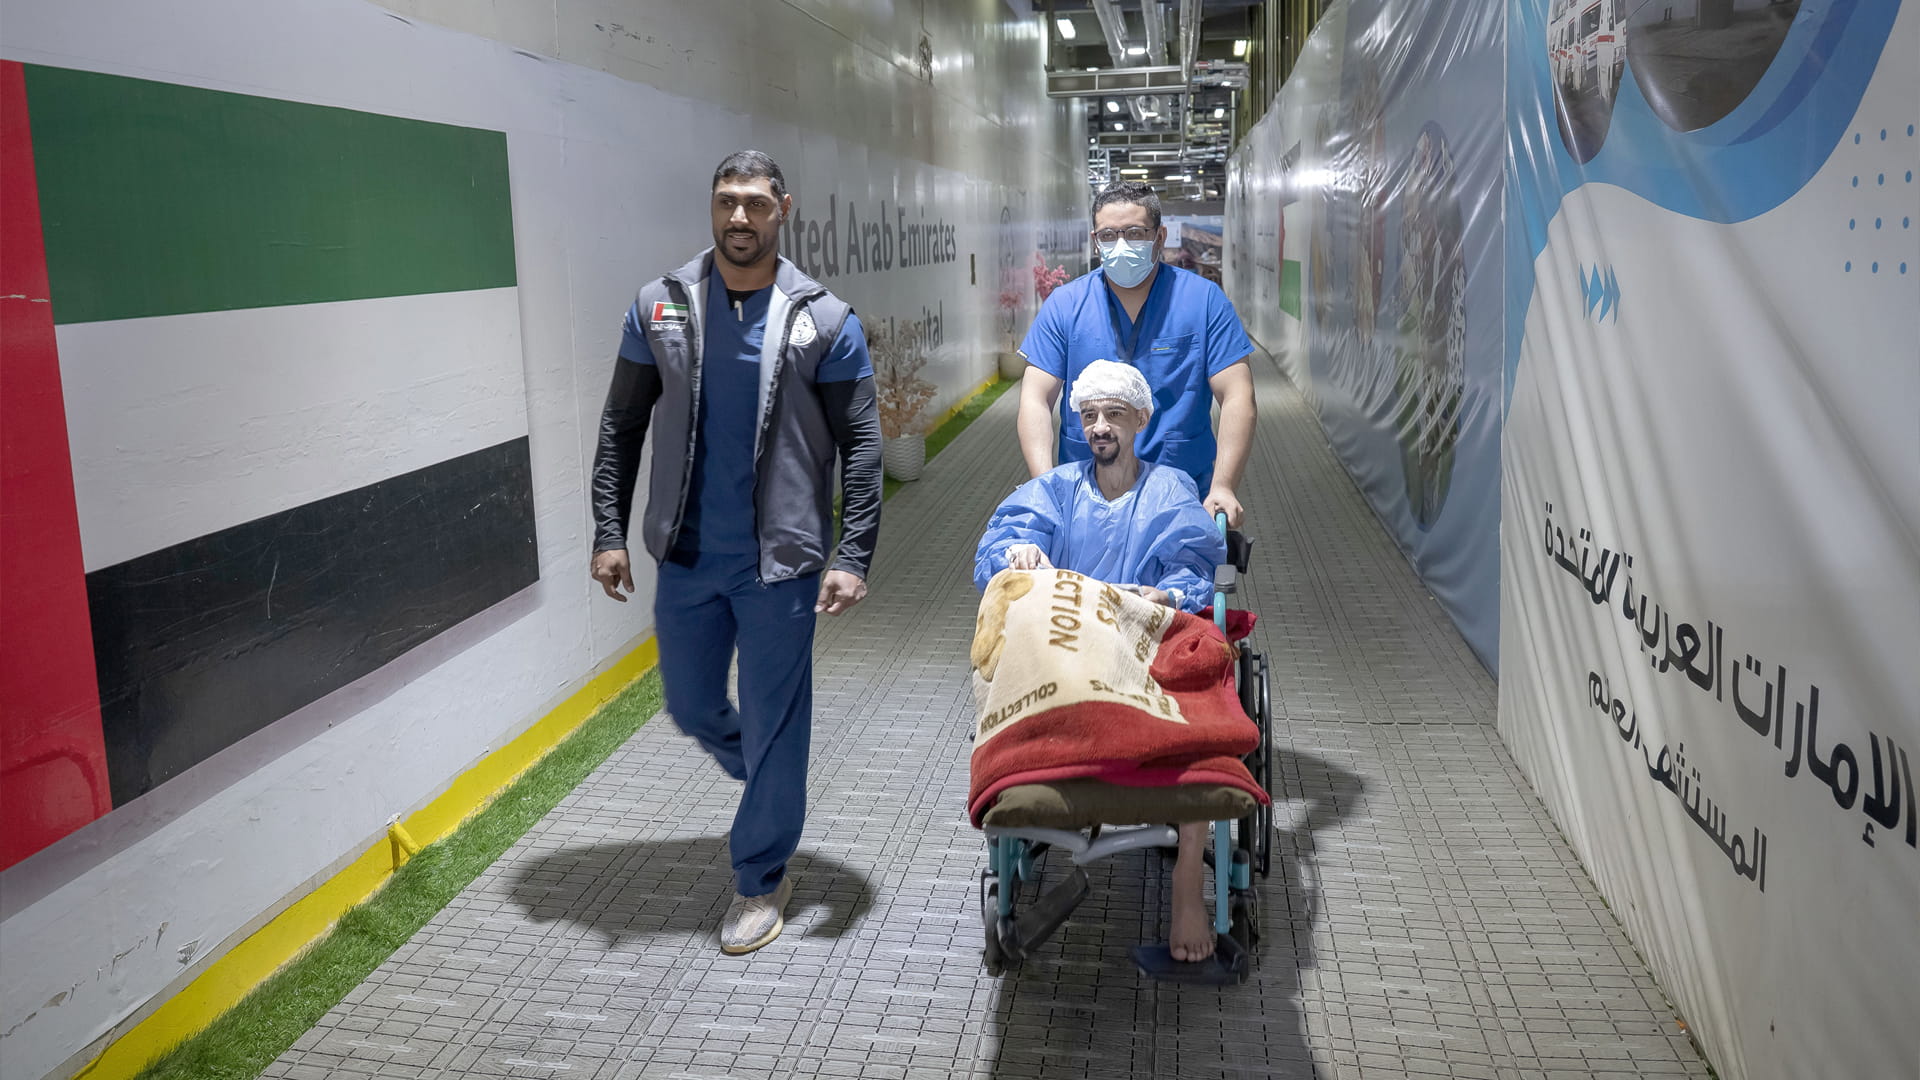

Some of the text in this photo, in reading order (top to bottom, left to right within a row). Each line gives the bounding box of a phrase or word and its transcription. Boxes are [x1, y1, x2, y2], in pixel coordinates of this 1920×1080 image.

[779, 194, 956, 279] ited Arab Emirates
[1049, 570, 1084, 652] ECTION
[1732, 654, 1918, 849] الإمارات
